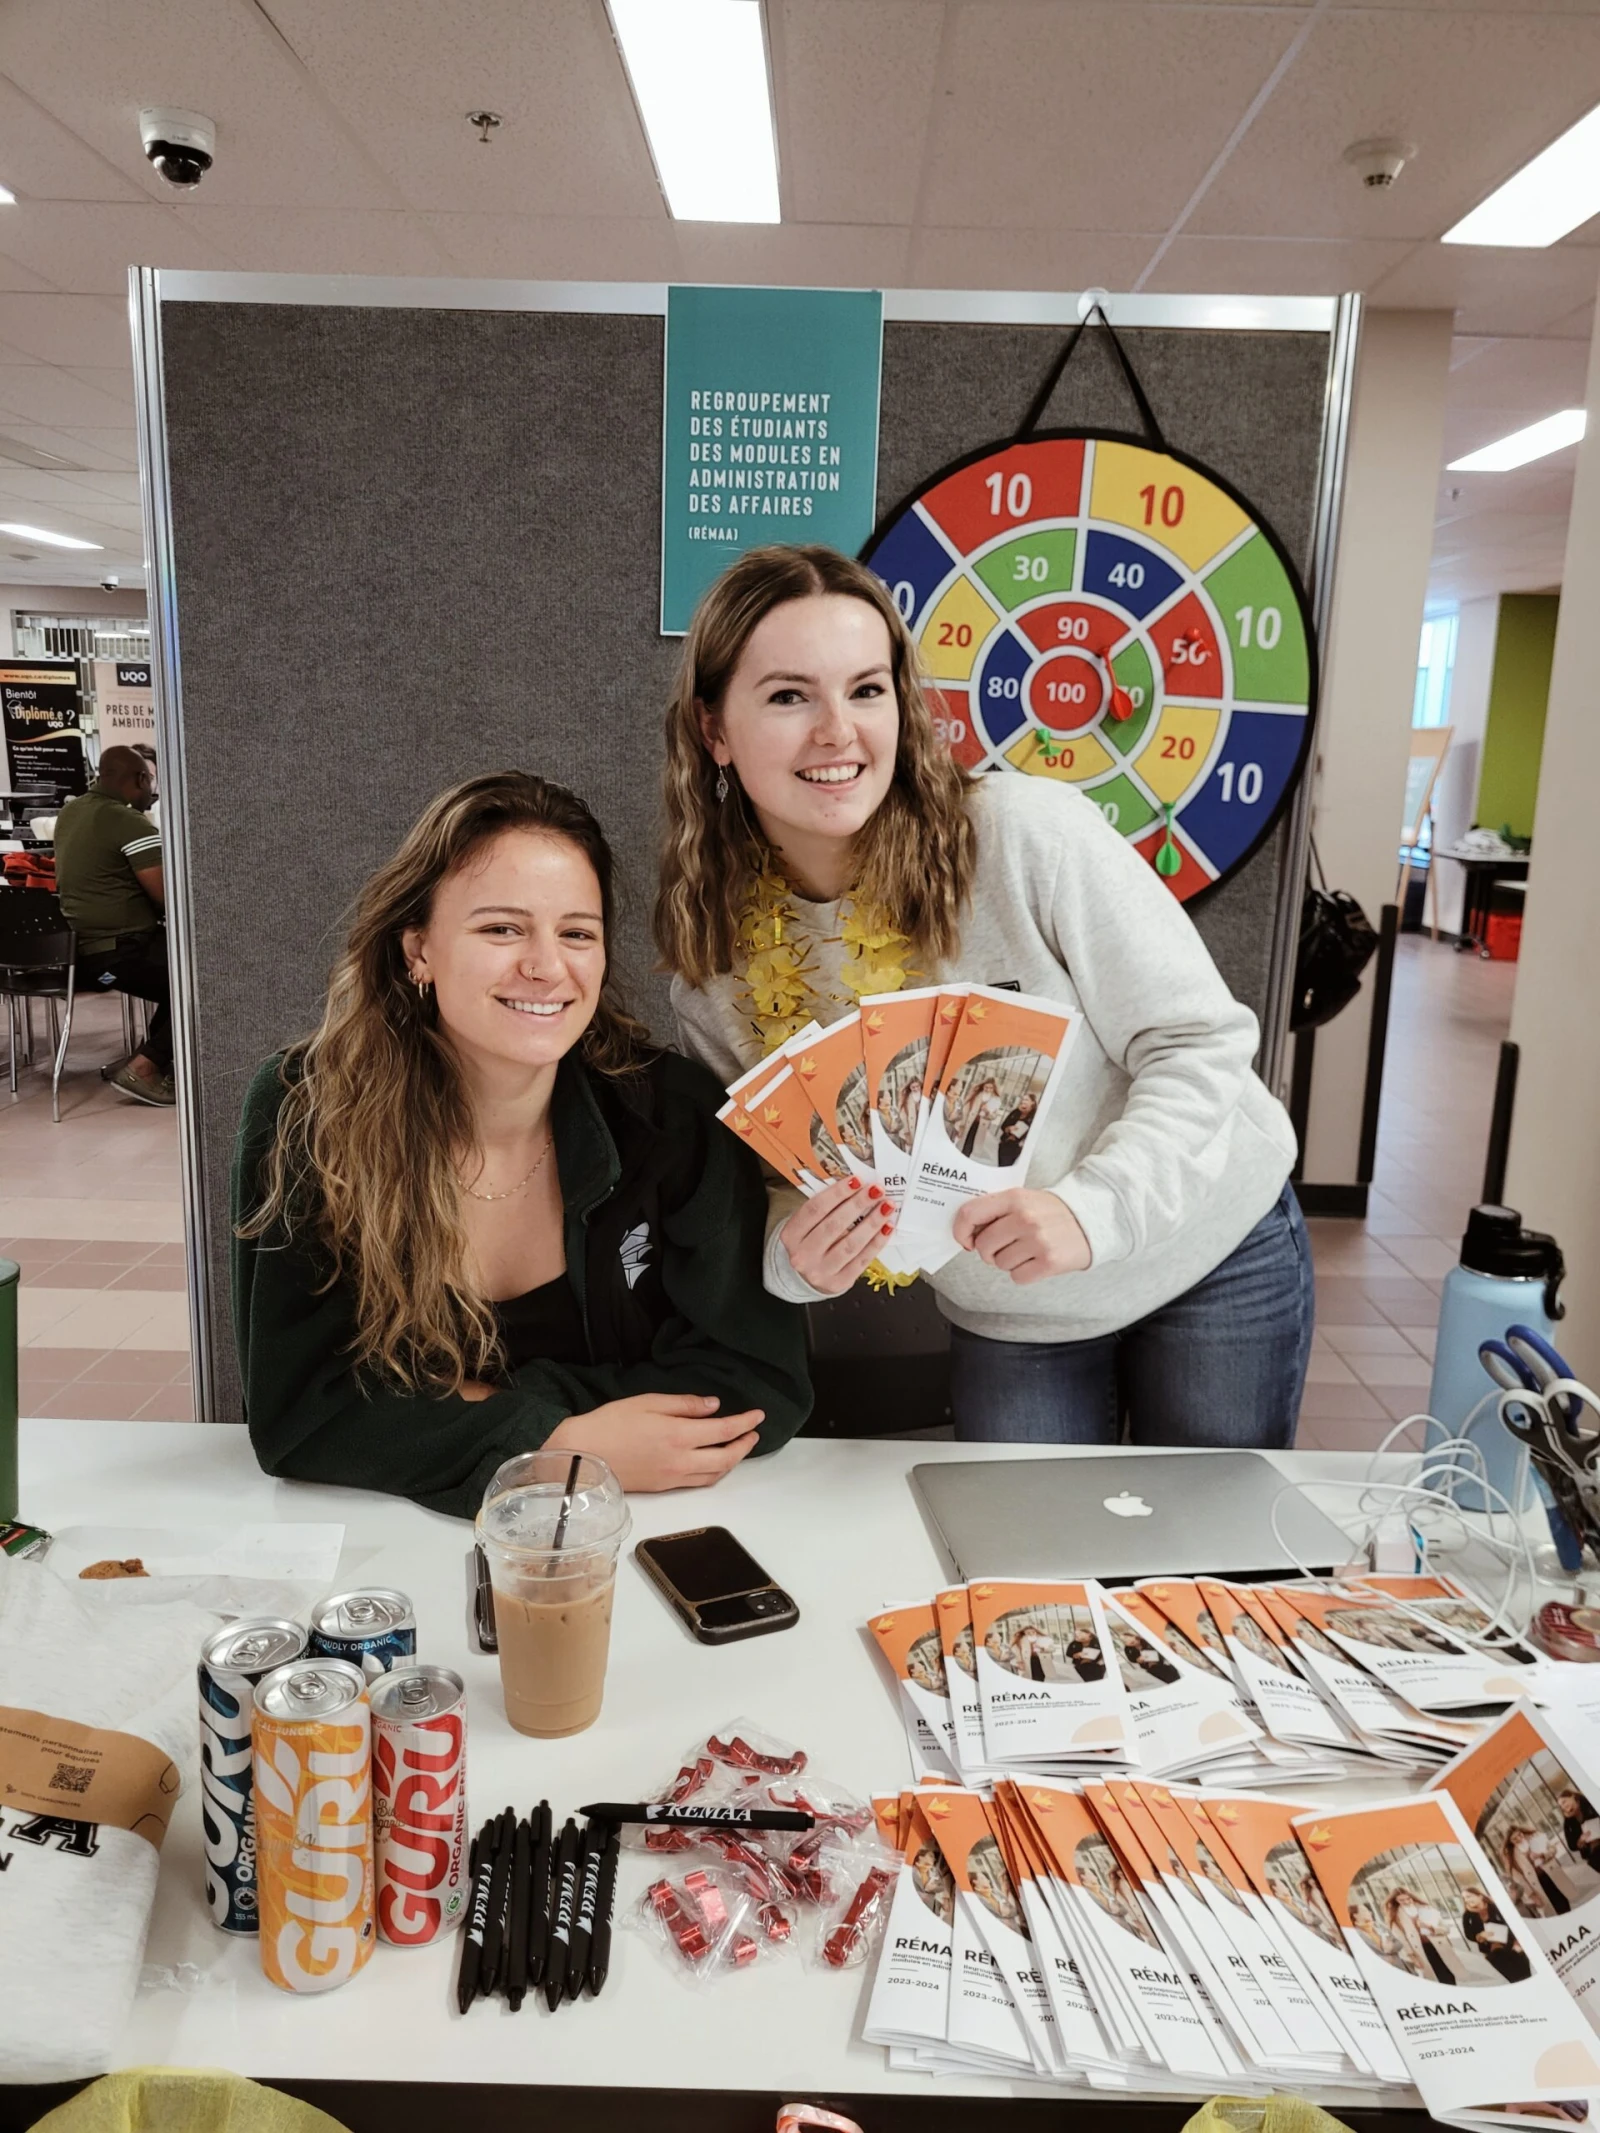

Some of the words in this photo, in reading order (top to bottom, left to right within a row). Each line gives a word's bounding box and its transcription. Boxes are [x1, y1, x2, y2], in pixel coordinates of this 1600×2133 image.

[691, 391, 831, 413] REGROUPEMENT
[690, 417, 723, 437] DES
[730, 415, 828, 439] ÉTUDIANTS
[690, 443, 722, 463] DES
[730, 444, 811, 465] MODULES
[819, 446, 841, 466] EN
[689, 469, 840, 491] ADMINISTRATION
[689, 494, 721, 513] DES
[729, 496, 813, 515] AFFAIRES
[985, 472, 1032, 518] 10
[1139, 484, 1185, 528] 10
[688, 526, 738, 541] (RÉMAA)
[1012, 555, 1049, 582] 30
[1107, 562, 1145, 590] 40
[937, 623, 973, 648] 20
[1057, 616, 1090, 642] 90
[1234, 605, 1282, 650] 10
[1170, 638, 1206, 667] 50
[120, 671, 148, 683] UQO
[987, 676, 1020, 700] 80
[5, 688, 37, 700] Bientôt
[1046, 682, 1086, 704] 100
[106, 703, 130, 716] PRÈS
[133, 705, 145, 716] DE
[47, 720, 64, 729] UQO
[1160, 735, 1195, 760] 20
[1216, 762, 1264, 805] 10
[921, 1162, 968, 1182] RÉMAA
[350, 1635, 392, 1651] ORGANIC
[991, 1691, 1052, 1703] RÉMAA
[371, 1718, 402, 1733] RGANIC
[378, 1713, 463, 1945] GURU
[276, 1698, 371, 1992] GURU
[448, 1798, 466, 1888] ORGANIC
[895, 1936, 953, 1957] RÉMA
[1545, 1925, 1591, 1965] MAA
[887, 1976, 940, 1991] 2023-2024
[1130, 1966, 1183, 1986] RÉMA
[1329, 1974, 1371, 1993] RÉM
[1573, 1977, 1596, 1998] -2024
[963, 1989, 1016, 2009] 2023-2024
[1066, 2000, 1099, 2015] 2023-2
[1396, 2001, 1478, 2021] RÉMAA
[1419, 2046, 1476, 2060] 2023-2024
